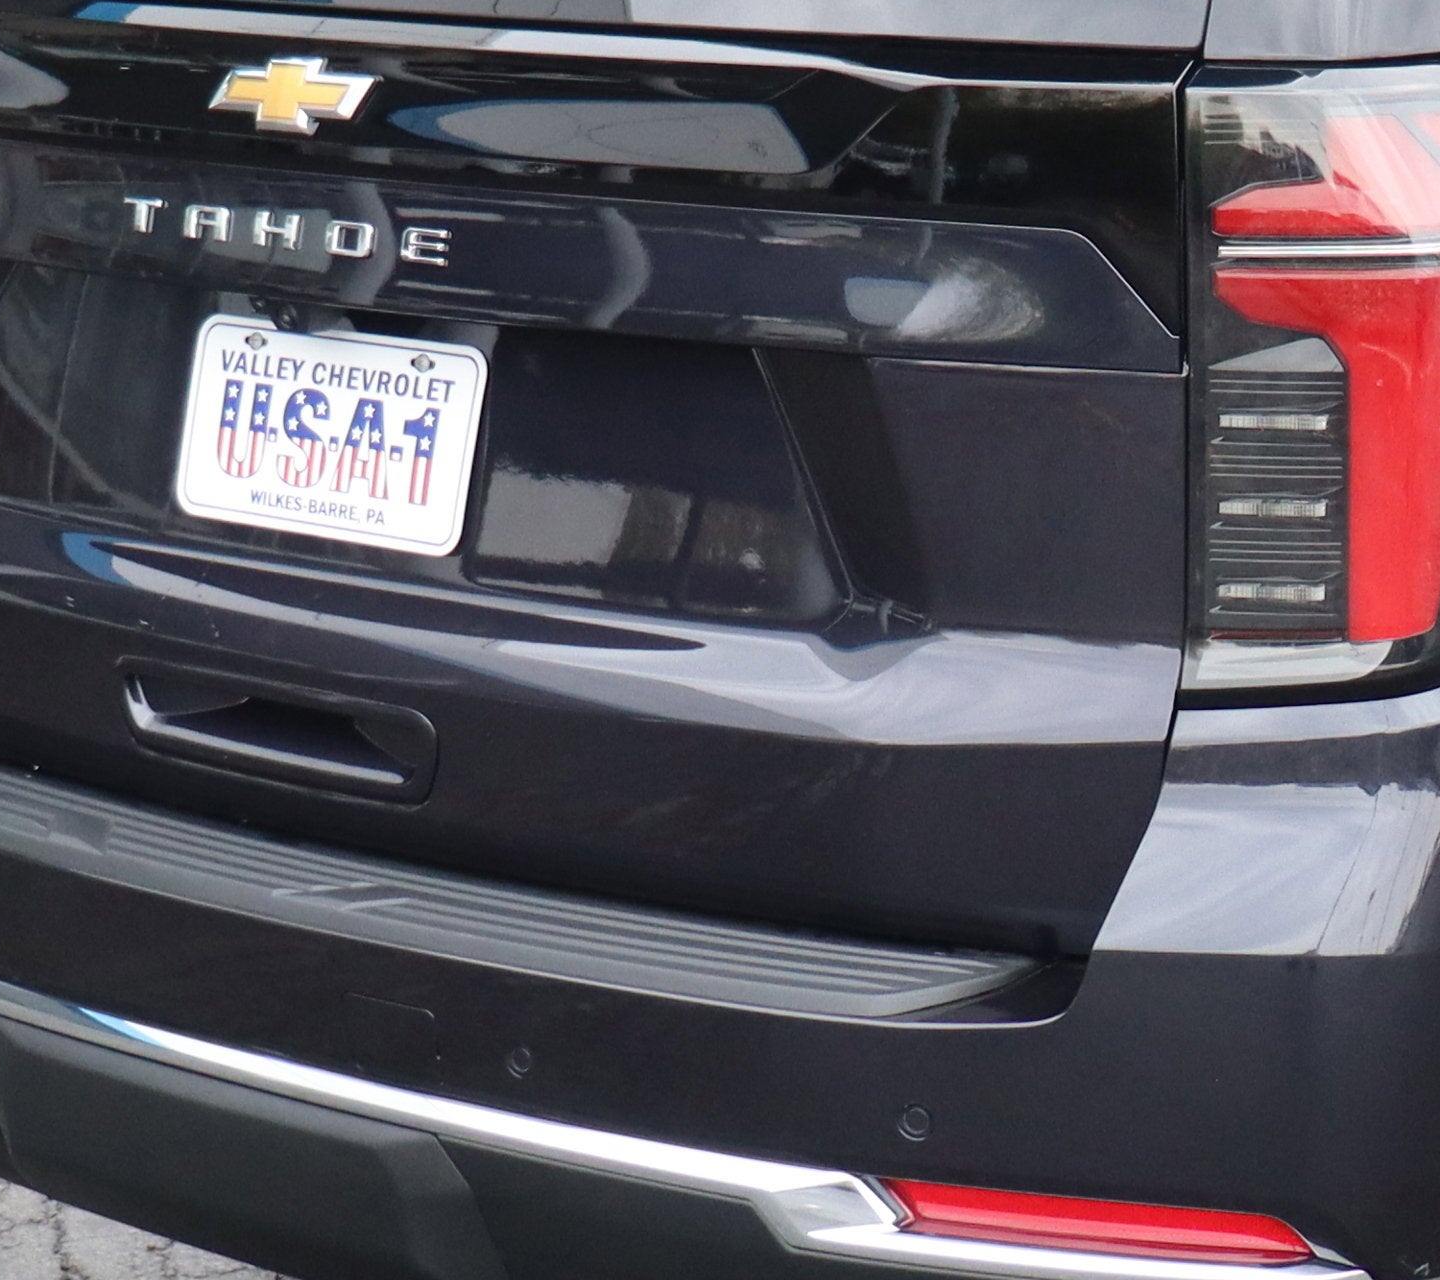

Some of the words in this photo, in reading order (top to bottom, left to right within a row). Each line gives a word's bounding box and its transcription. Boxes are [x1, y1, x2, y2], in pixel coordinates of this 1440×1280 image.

[123, 198, 453, 267] TAHOE
[221, 349, 305, 381] VALLEY
[311, 362, 456, 403] CHEVROLET
[366, 508, 385, 526] PA
